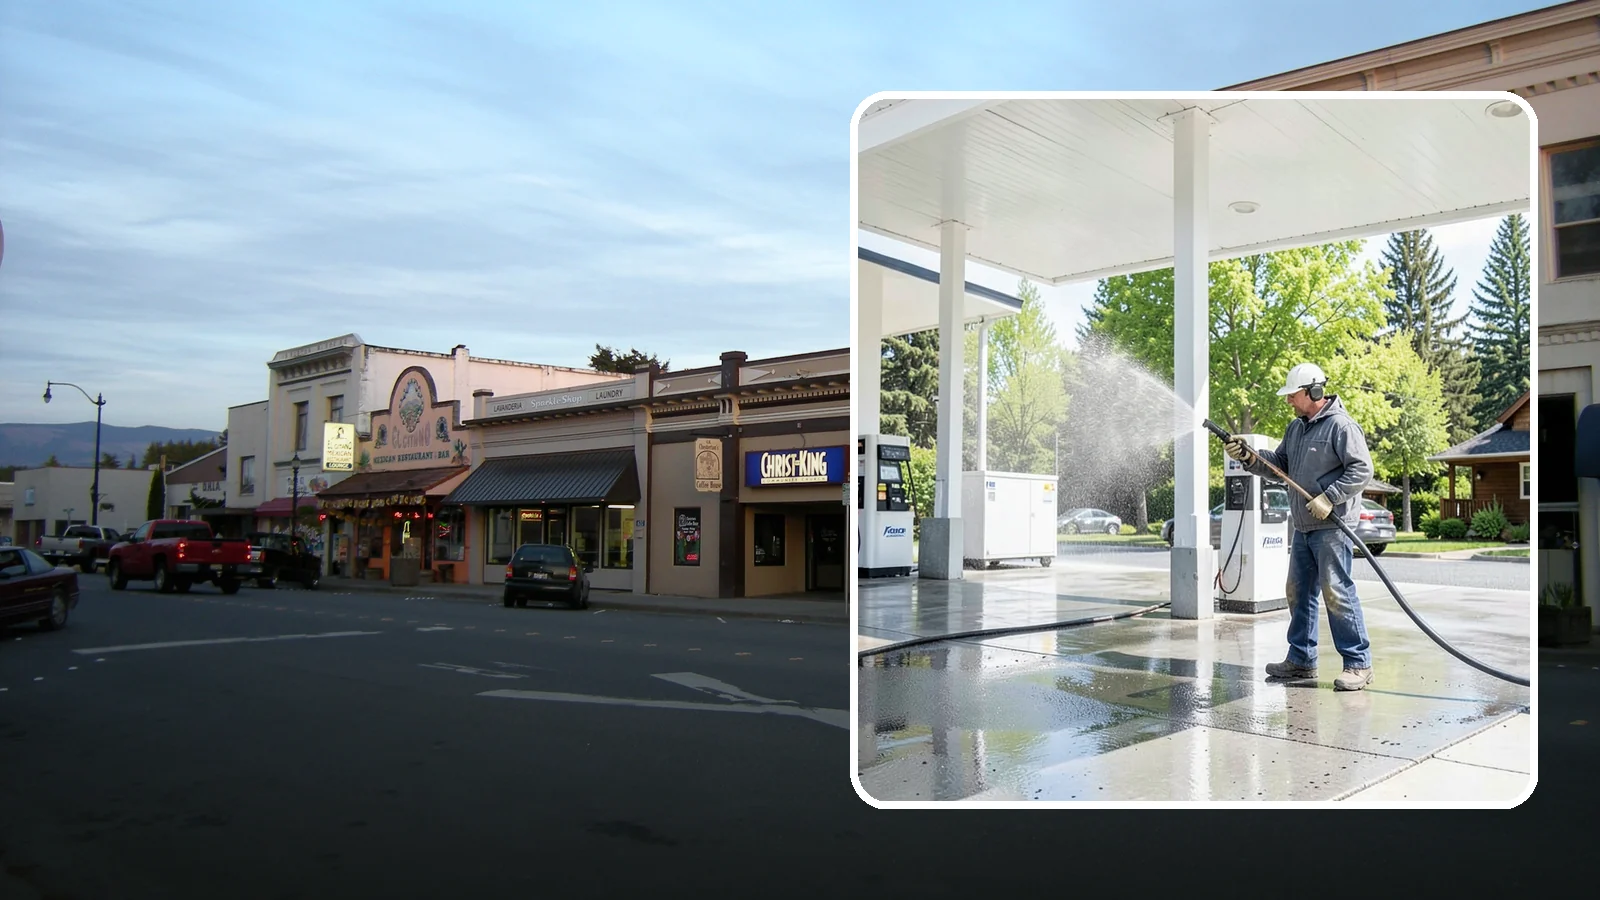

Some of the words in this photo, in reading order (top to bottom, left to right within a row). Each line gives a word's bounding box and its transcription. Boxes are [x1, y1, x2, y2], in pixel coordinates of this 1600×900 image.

[531, 397, 560, 408] Sparkle
[561, 394, 582, 406] Shop
[596, 389, 623, 400] LAUNDRY
[494, 403, 522, 412] LAVANDERIA
[397, 451, 433, 462] RESTAURANT
[438, 449, 450, 459] BAR
[761, 452, 797, 477] CHRIST
[799, 450, 827, 476] KING
